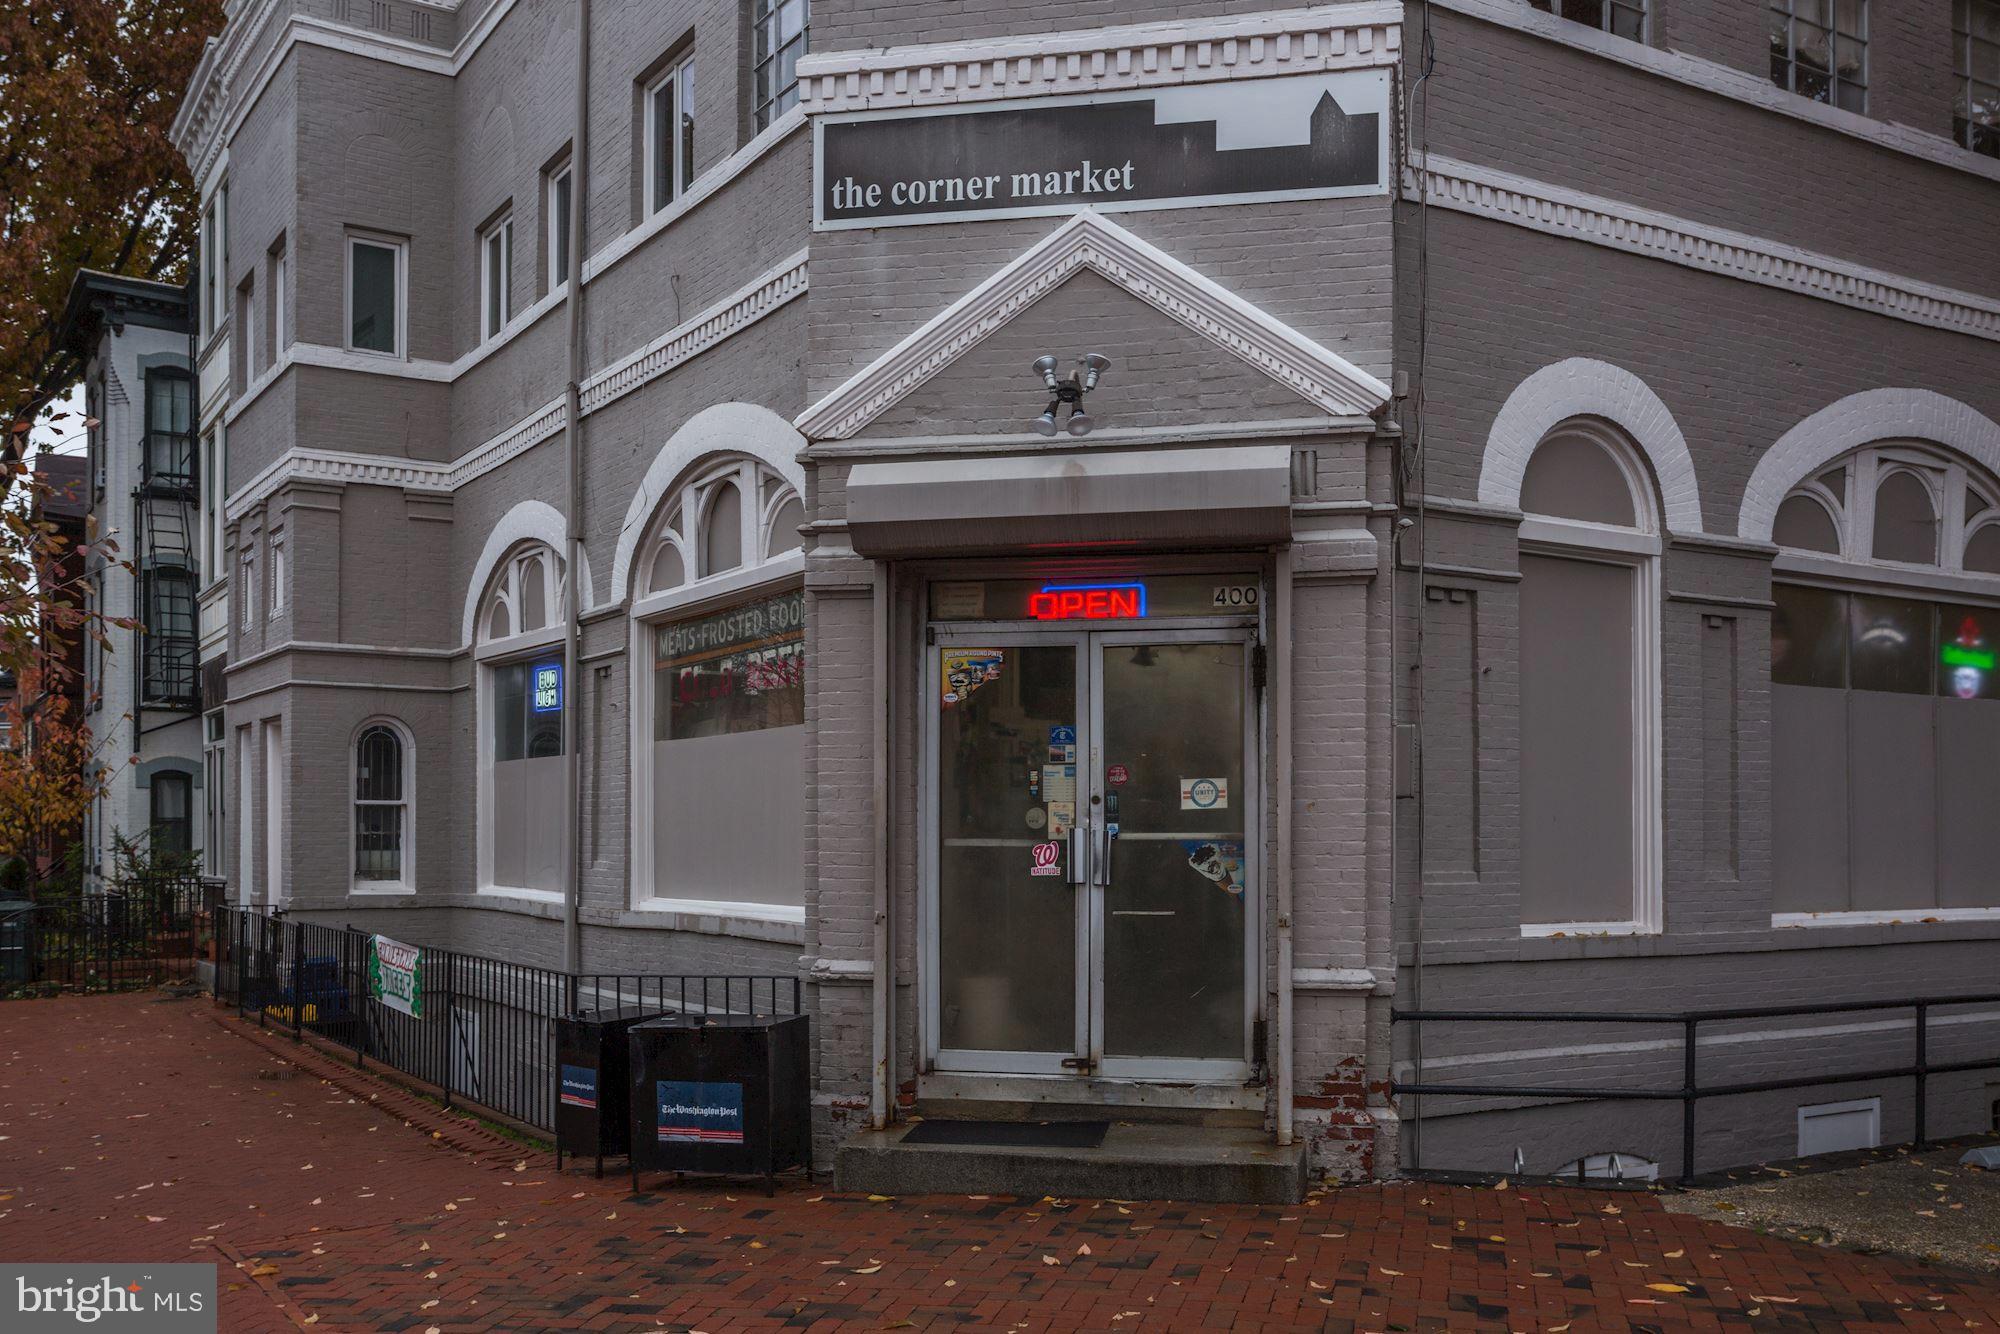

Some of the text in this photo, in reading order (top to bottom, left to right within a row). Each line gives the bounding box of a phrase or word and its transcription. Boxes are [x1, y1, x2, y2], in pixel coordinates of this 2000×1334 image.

[831, 160, 1135, 210] the corner market
[1030, 589, 1139, 619] OPEN
[1214, 587, 1258, 605] 400
[539, 670, 557, 689] BUD
[661, 1103, 738, 1117] The Washington Post
